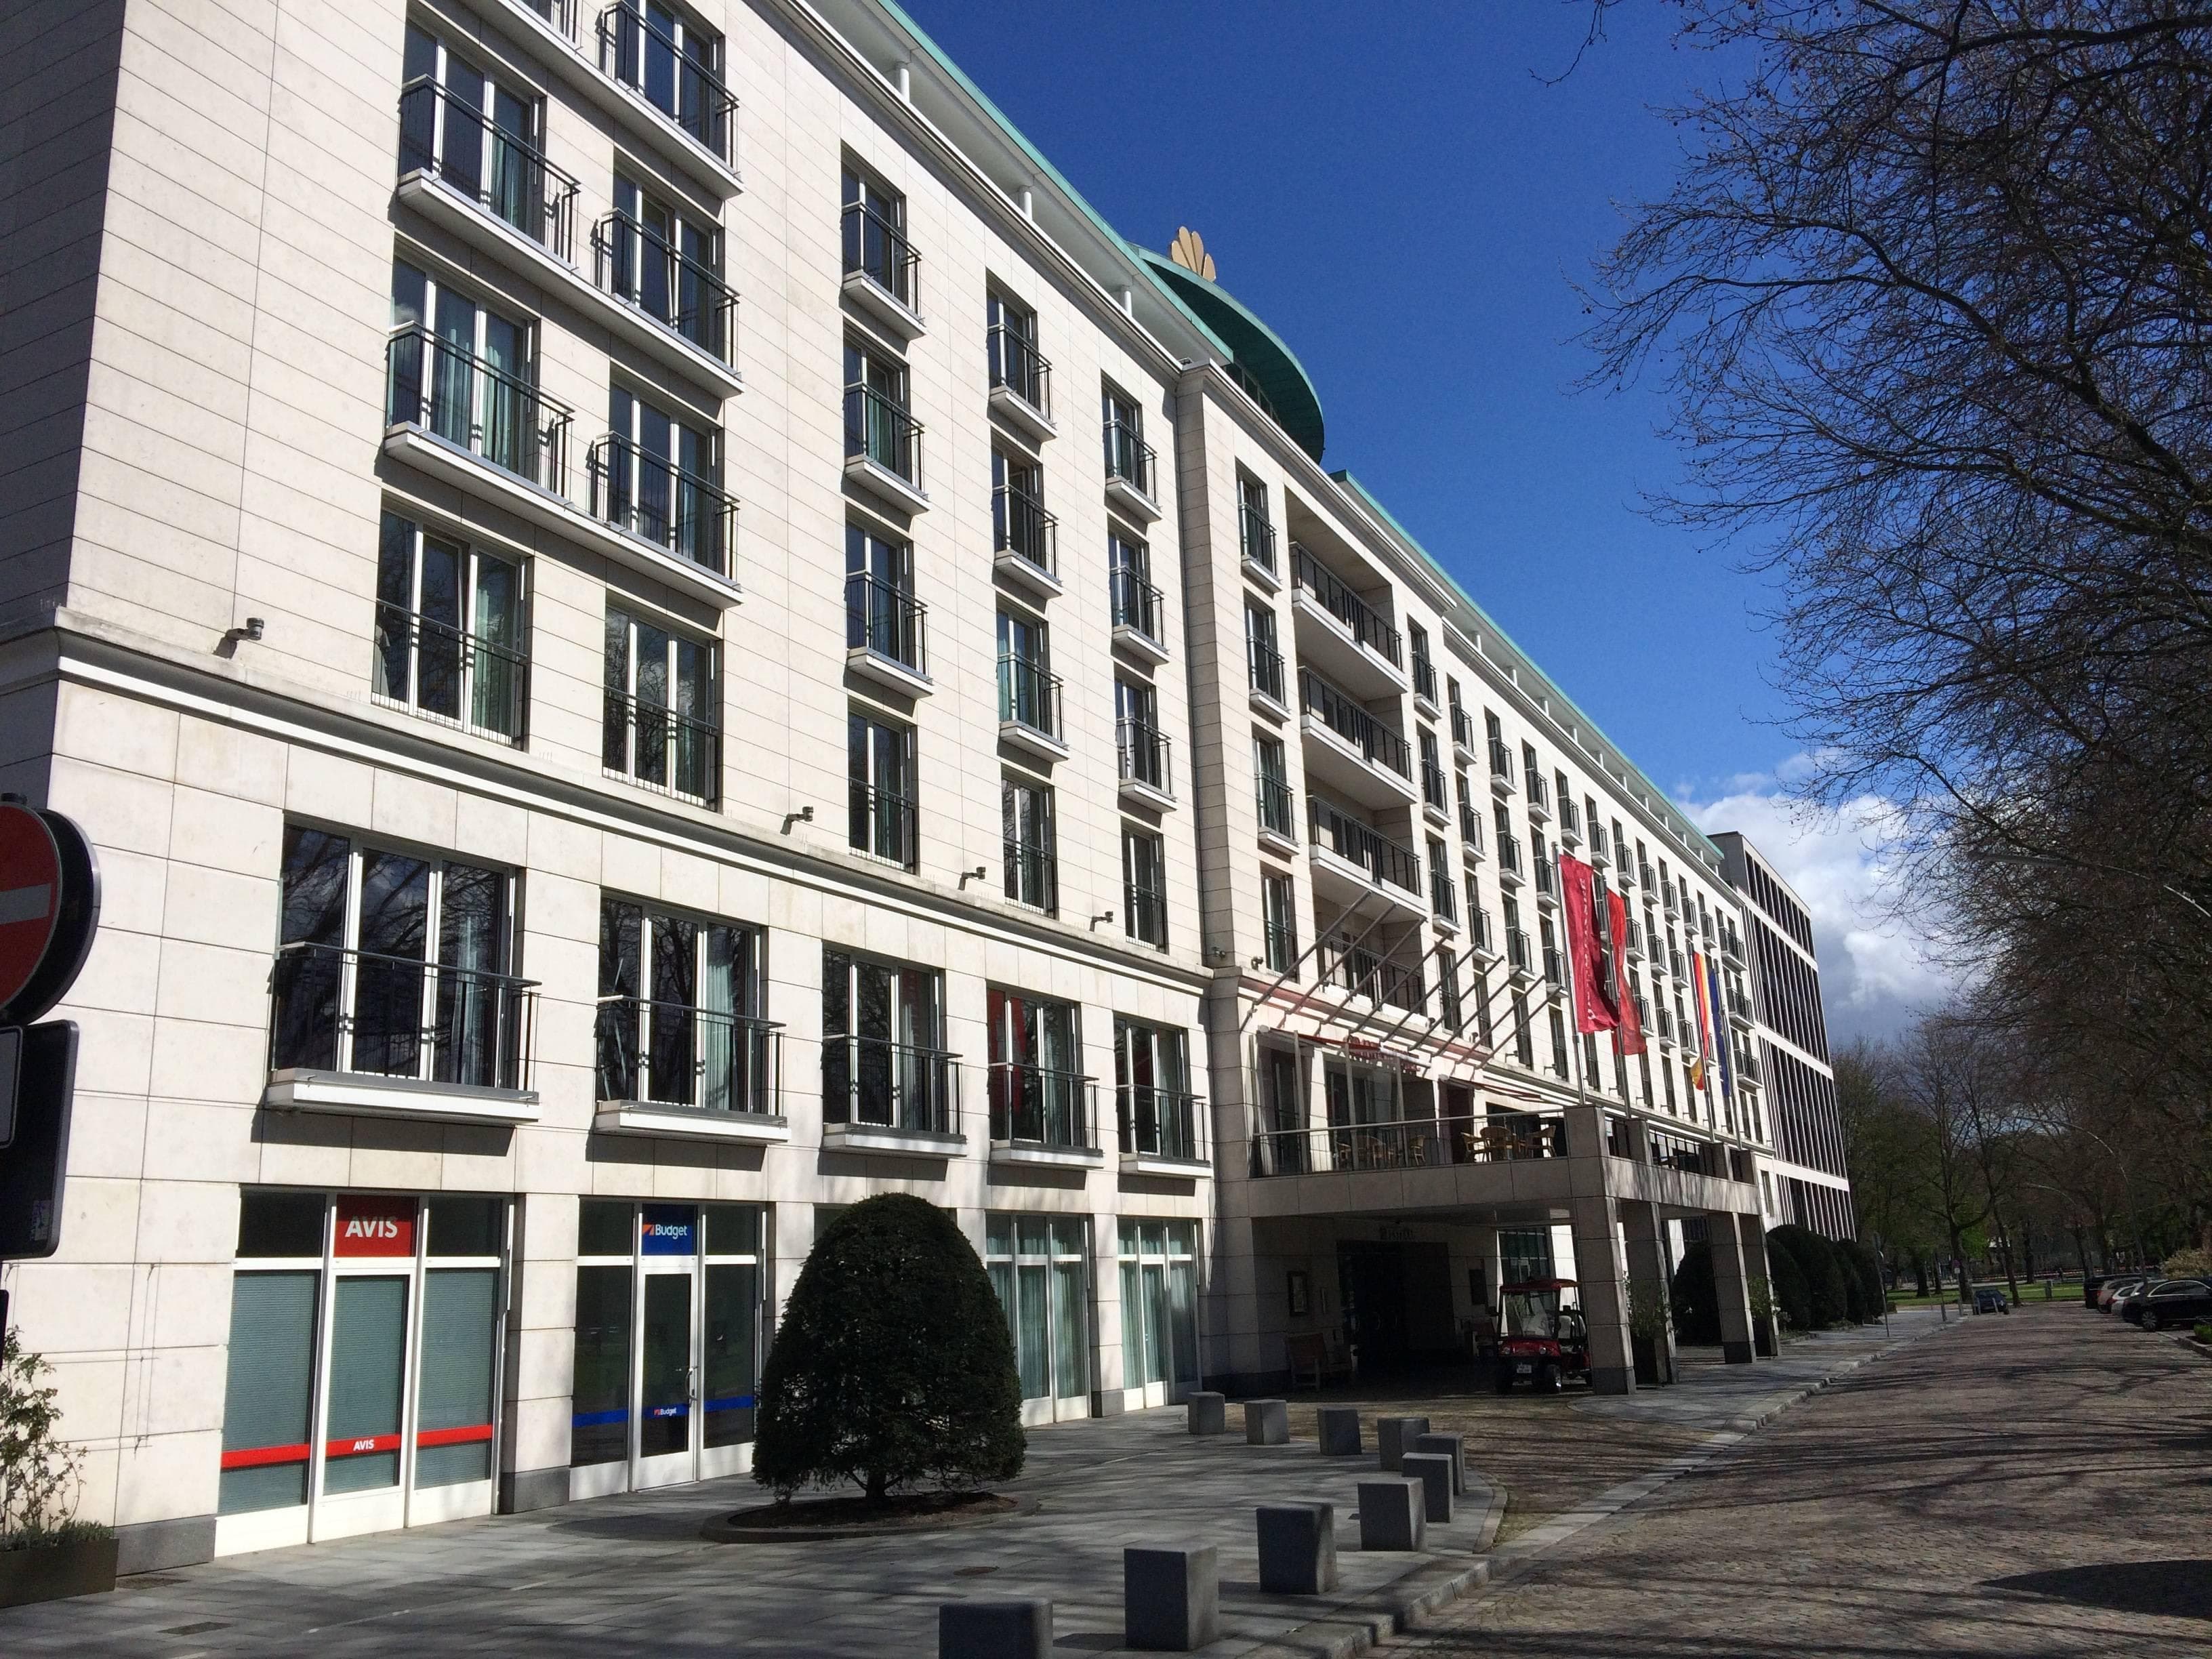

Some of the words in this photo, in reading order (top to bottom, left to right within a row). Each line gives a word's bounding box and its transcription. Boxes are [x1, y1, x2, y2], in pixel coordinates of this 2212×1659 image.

[344, 1216, 398, 1238] AVIS
[655, 1224, 688, 1240] Budget
[660, 1407, 677, 1416] Budget
[353, 1438, 375, 1452] AVIS
